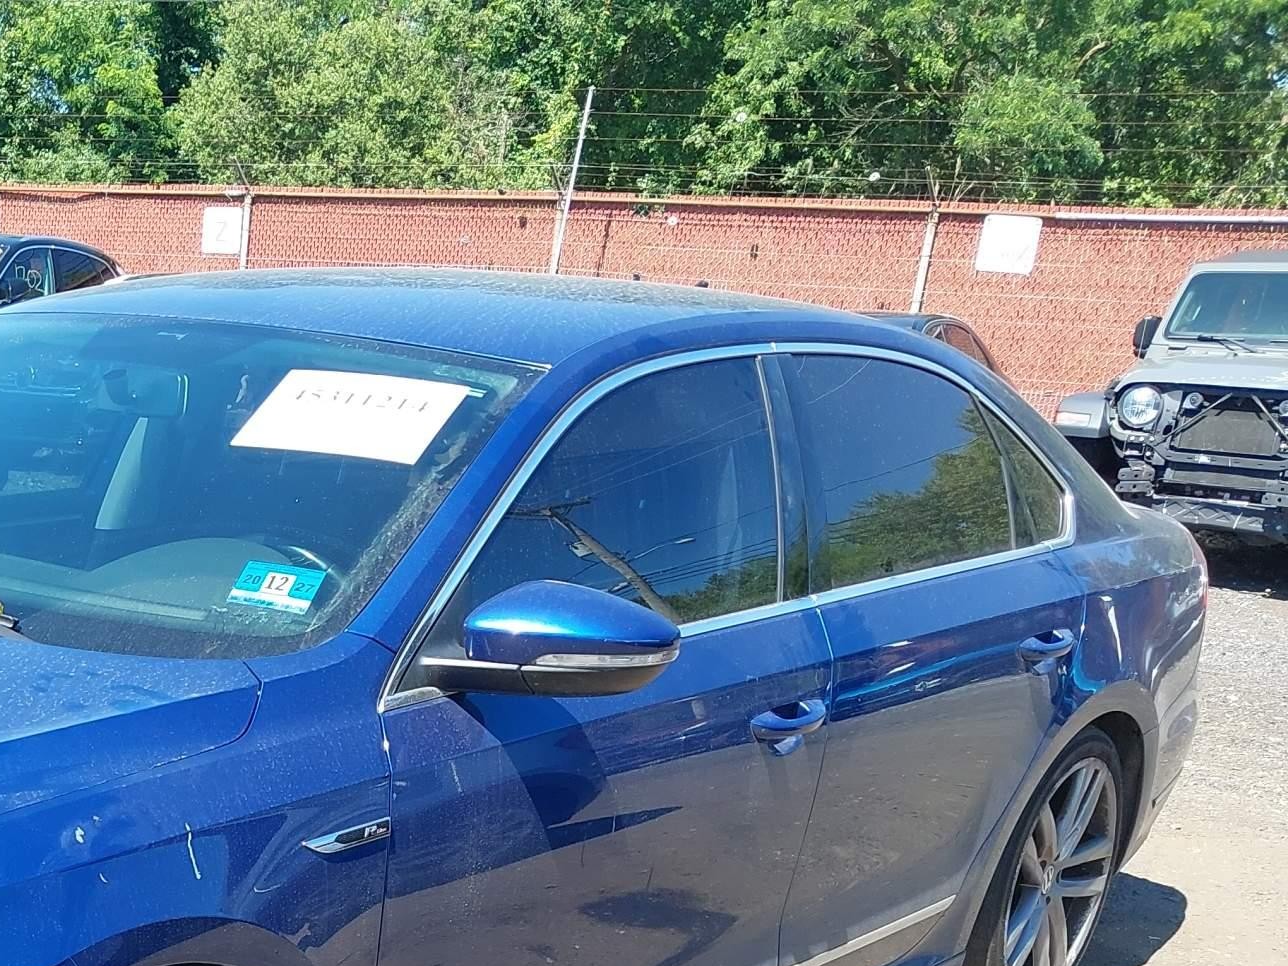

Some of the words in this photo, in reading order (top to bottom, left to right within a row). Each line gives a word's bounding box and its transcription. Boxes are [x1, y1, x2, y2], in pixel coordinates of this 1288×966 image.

[241, 574, 261, 585] 20
[264, 575, 289, 591] 12
[294, 582, 316, 593] 27
